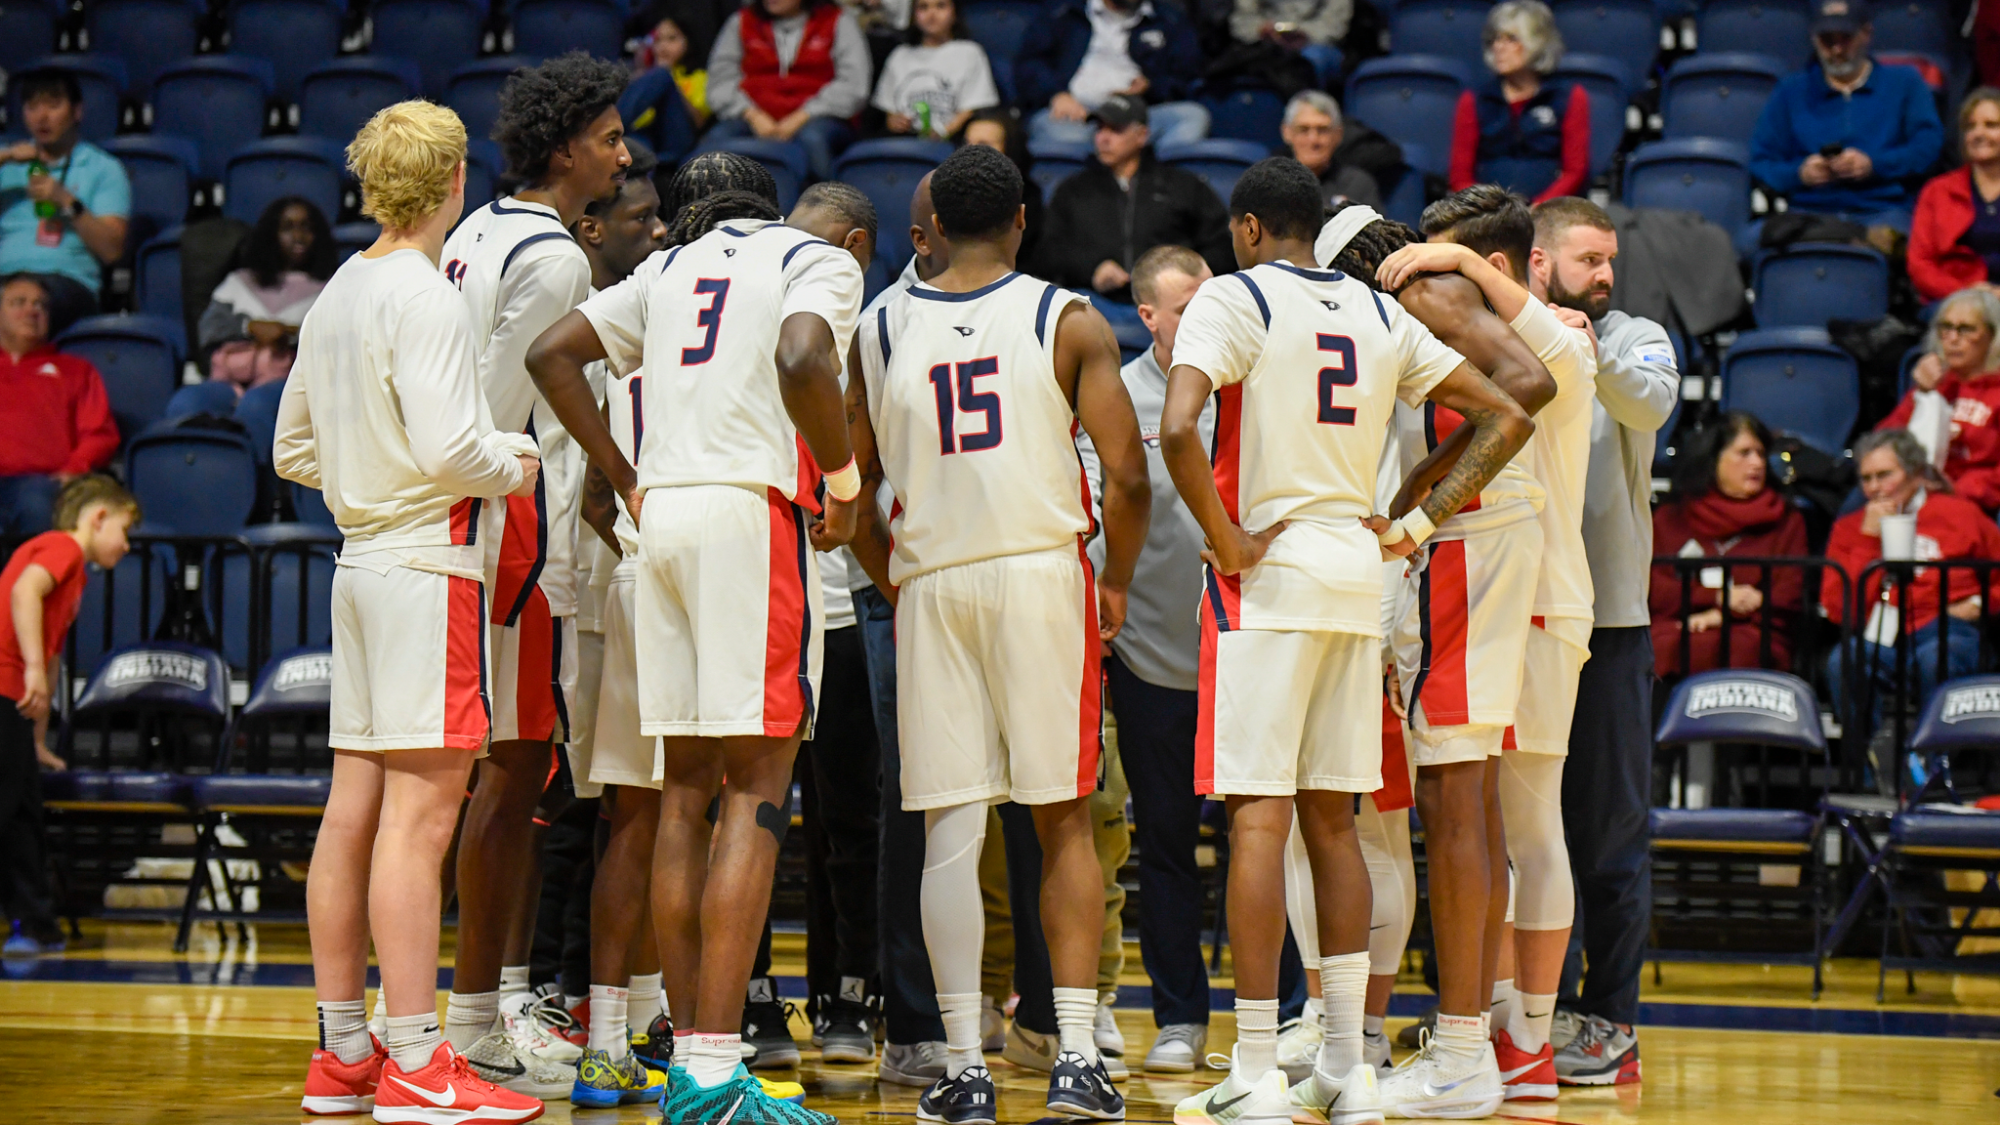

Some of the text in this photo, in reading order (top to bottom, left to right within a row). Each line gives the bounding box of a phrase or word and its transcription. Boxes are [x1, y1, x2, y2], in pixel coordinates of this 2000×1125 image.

[681, 277, 732, 367] 3
[928, 355, 1004, 456] 15
[1315, 332, 1358, 427] 2
[1690, 694, 1796, 717] INDIANA
[1691, 683, 1796, 704] SOUTHERN
